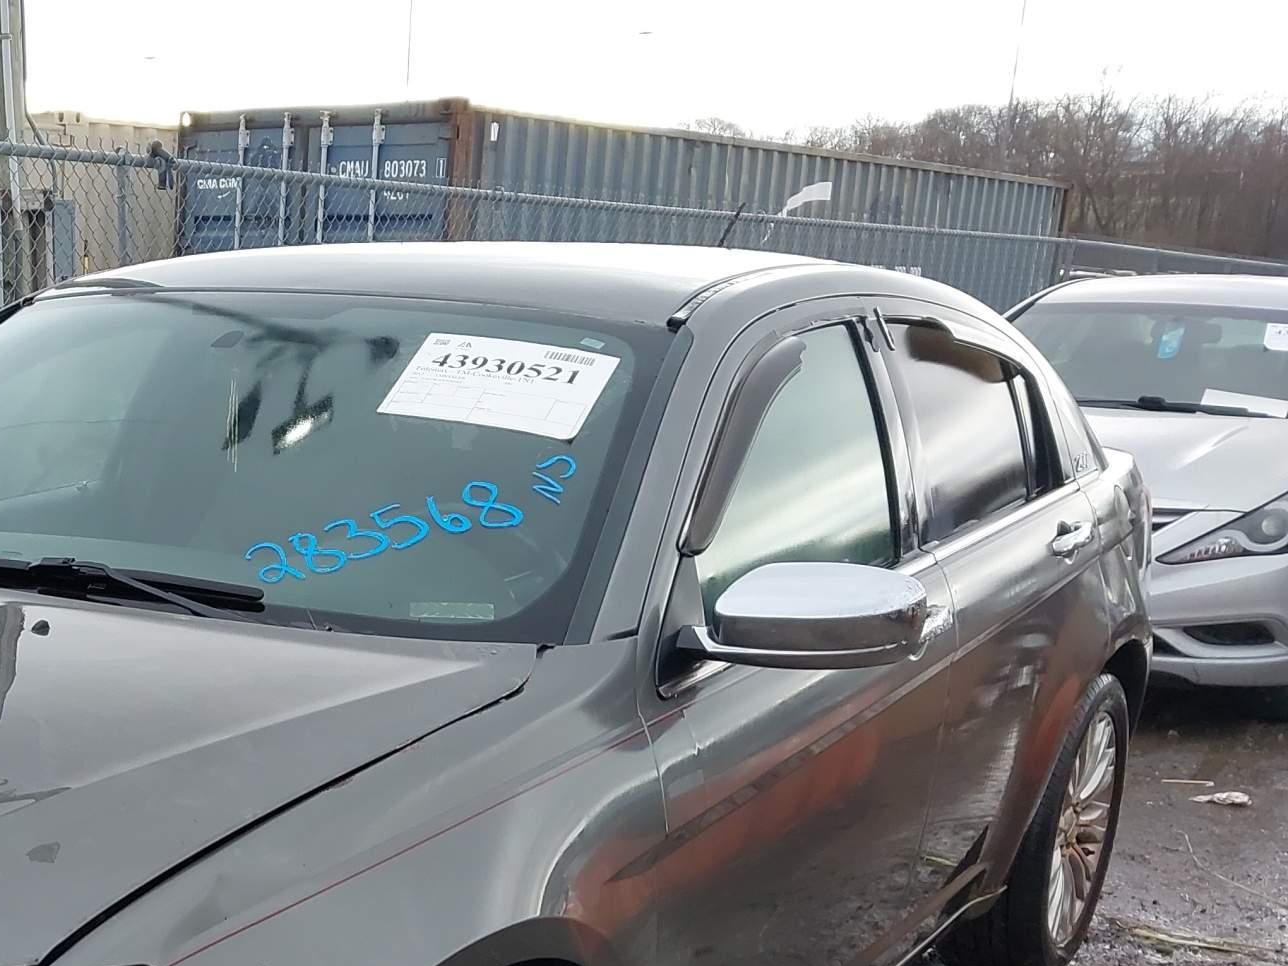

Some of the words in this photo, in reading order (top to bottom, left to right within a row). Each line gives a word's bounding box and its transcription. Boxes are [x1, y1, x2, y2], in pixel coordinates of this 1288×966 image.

[338, 160, 369, 178] CMAU
[383, 159, 427, 178] 803073
[431, 352, 582, 385] 43930521
[244, 480, 524, 584] 283568
